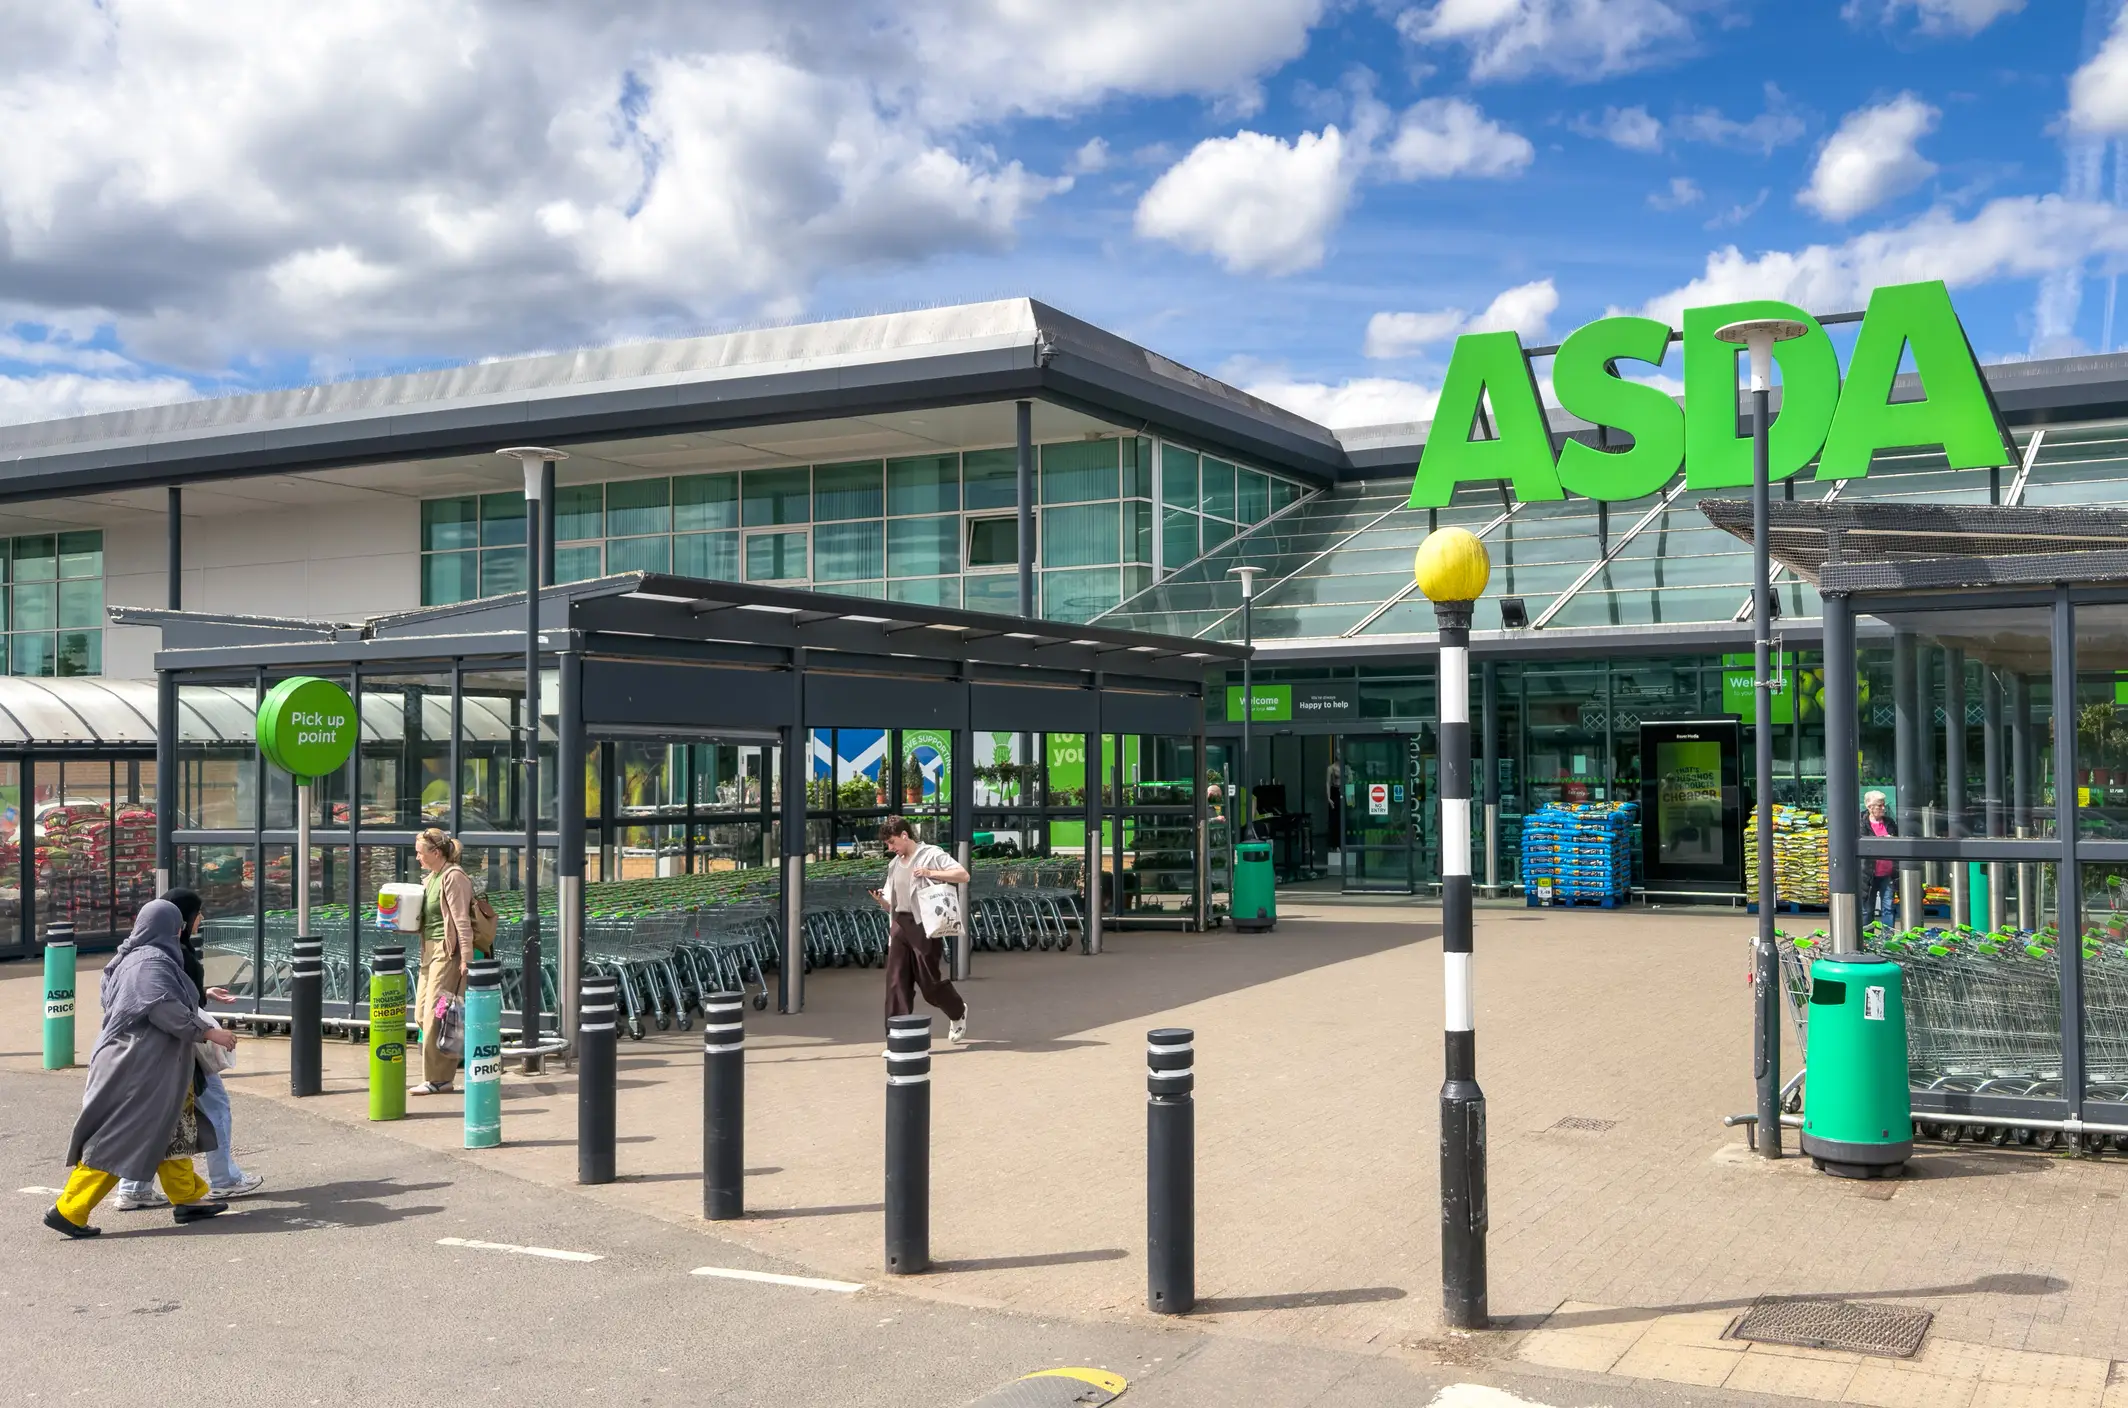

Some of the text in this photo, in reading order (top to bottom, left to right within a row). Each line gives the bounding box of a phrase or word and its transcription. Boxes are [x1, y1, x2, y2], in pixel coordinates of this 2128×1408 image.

[1407, 279, 2012, 510] ASDA
[1299, 701, 1349, 710] Happy to help
[291, 711, 345, 729] Pick up
[298, 729, 337, 746] point
[917, 735, 952, 774] SUPPORTING
[47, 989, 75, 1000] ASDA
[472, 1044, 501, 1058] ASD
